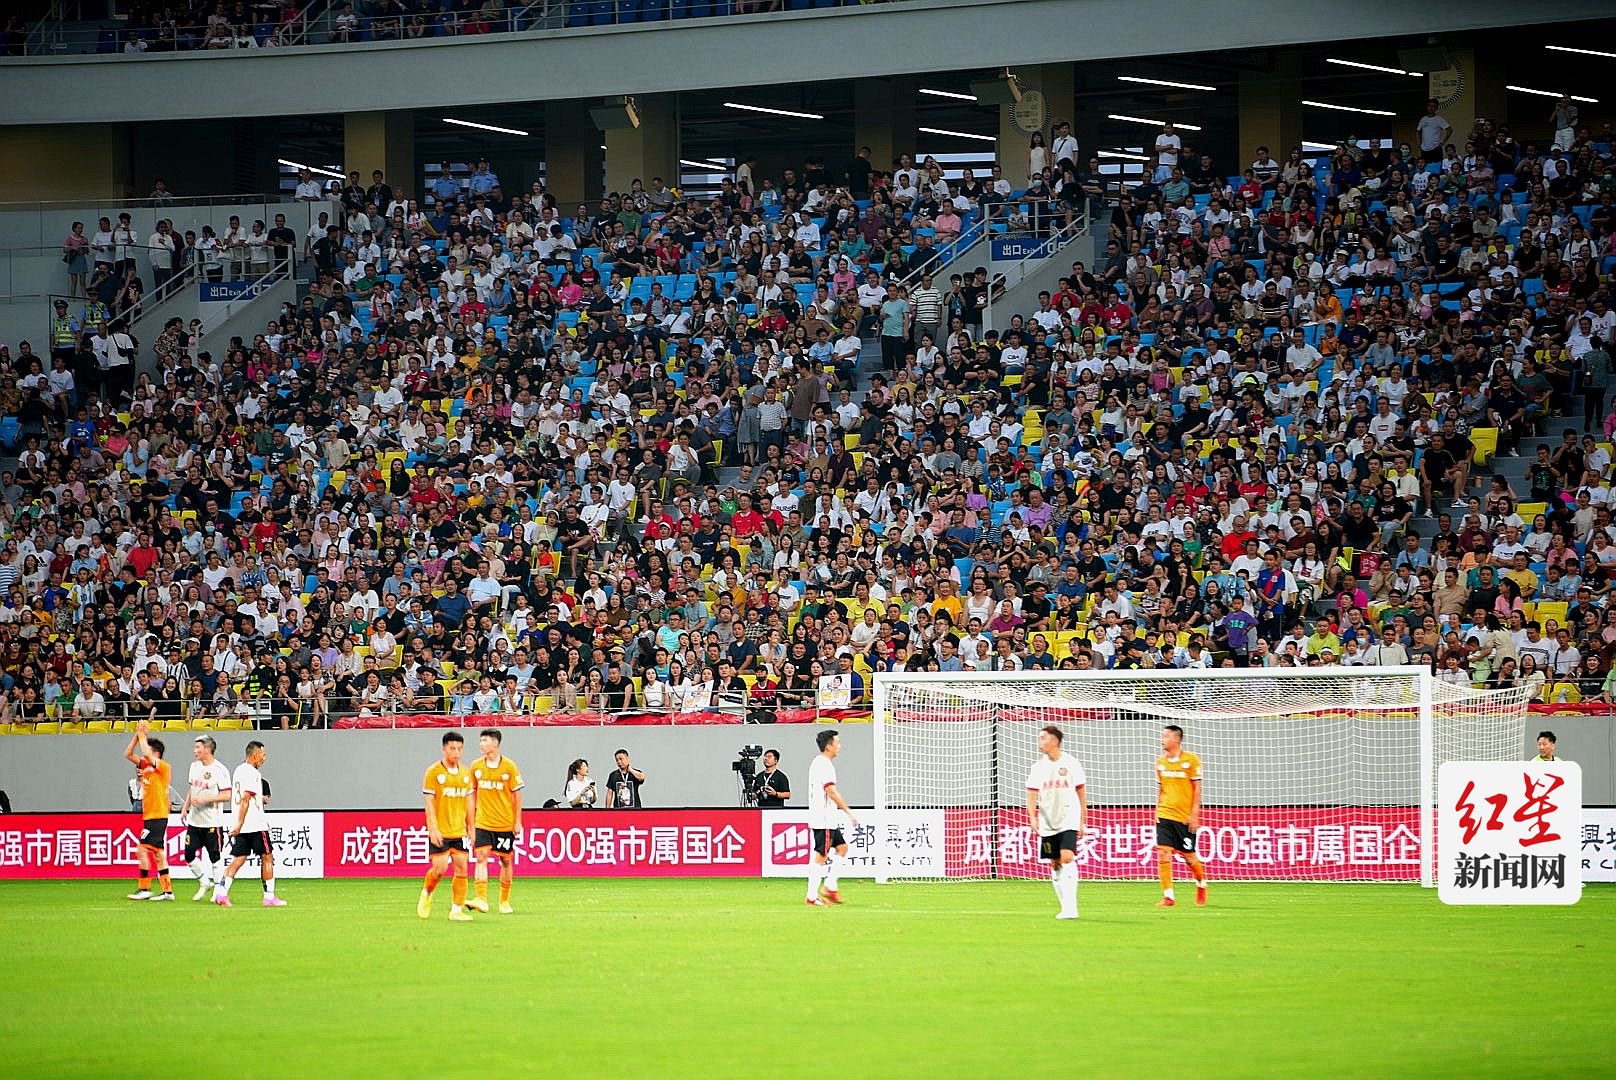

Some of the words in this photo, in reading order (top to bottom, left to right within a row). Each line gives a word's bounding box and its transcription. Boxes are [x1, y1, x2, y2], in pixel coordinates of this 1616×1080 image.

[1002, 244, 1022, 256] 出口
[210, 286, 228, 297] 出口
[0, 828, 141, 867] 强市属国企
[340, 824, 746, 866] 成都首500强市属国企
[496, 837, 511, 850] 74
[963, 823, 1421, 867] 成都家世界00强市属国企
[282, 857, 313, 867] CITY
